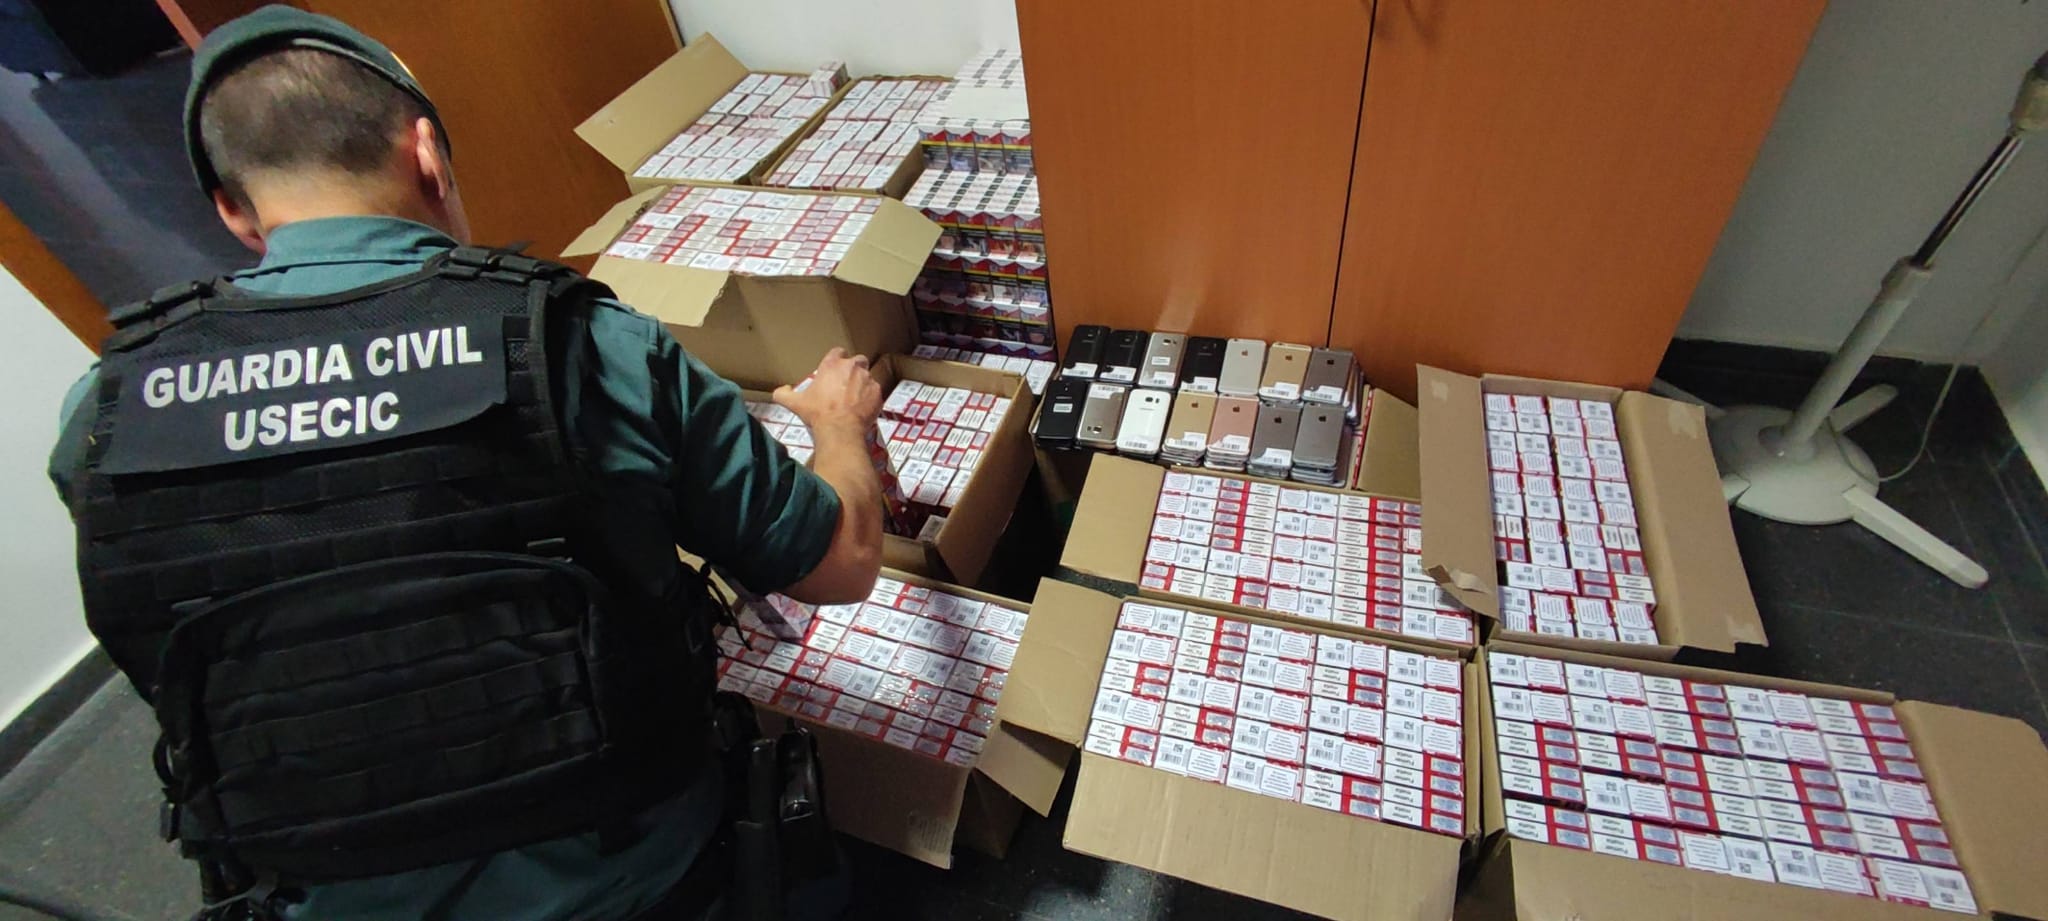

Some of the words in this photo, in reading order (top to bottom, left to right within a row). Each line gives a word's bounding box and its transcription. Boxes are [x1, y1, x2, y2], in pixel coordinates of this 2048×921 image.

[143, 343, 352, 408] GUARDIA
[366, 326, 483, 377] CIVIL
[224, 392, 399, 451] USECIC
